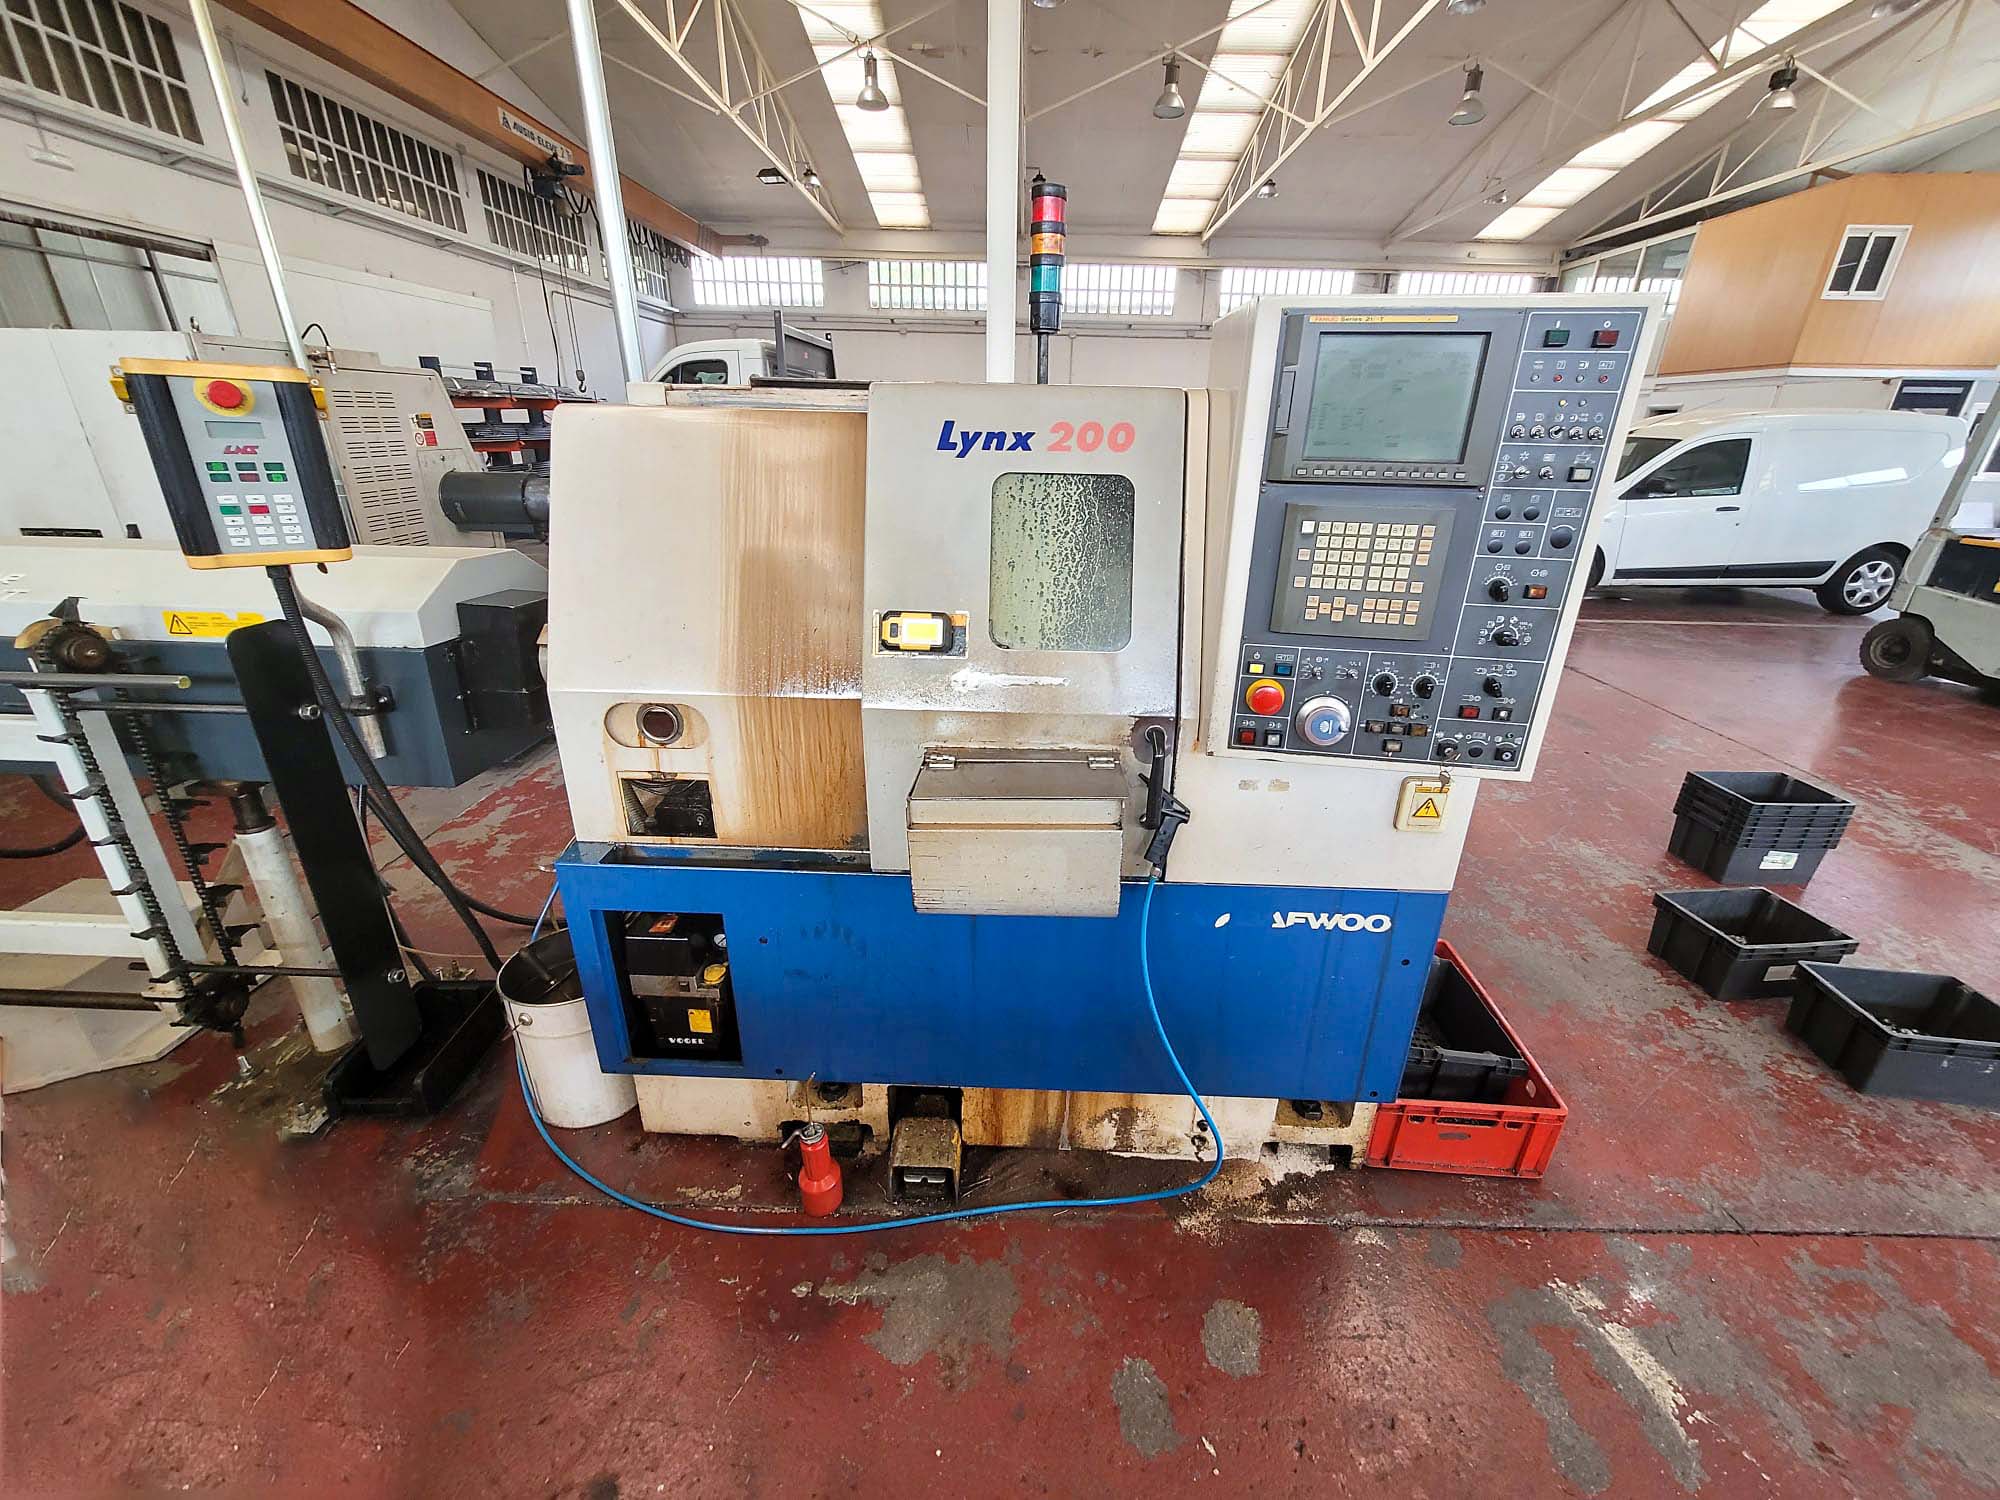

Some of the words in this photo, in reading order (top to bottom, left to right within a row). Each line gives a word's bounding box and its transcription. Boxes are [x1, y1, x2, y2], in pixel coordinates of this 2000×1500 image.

[936, 420, 1036, 458] Lynx
[1047, 421, 1136, 453] 200
[668, 1037, 705, 1045] VOGEL
